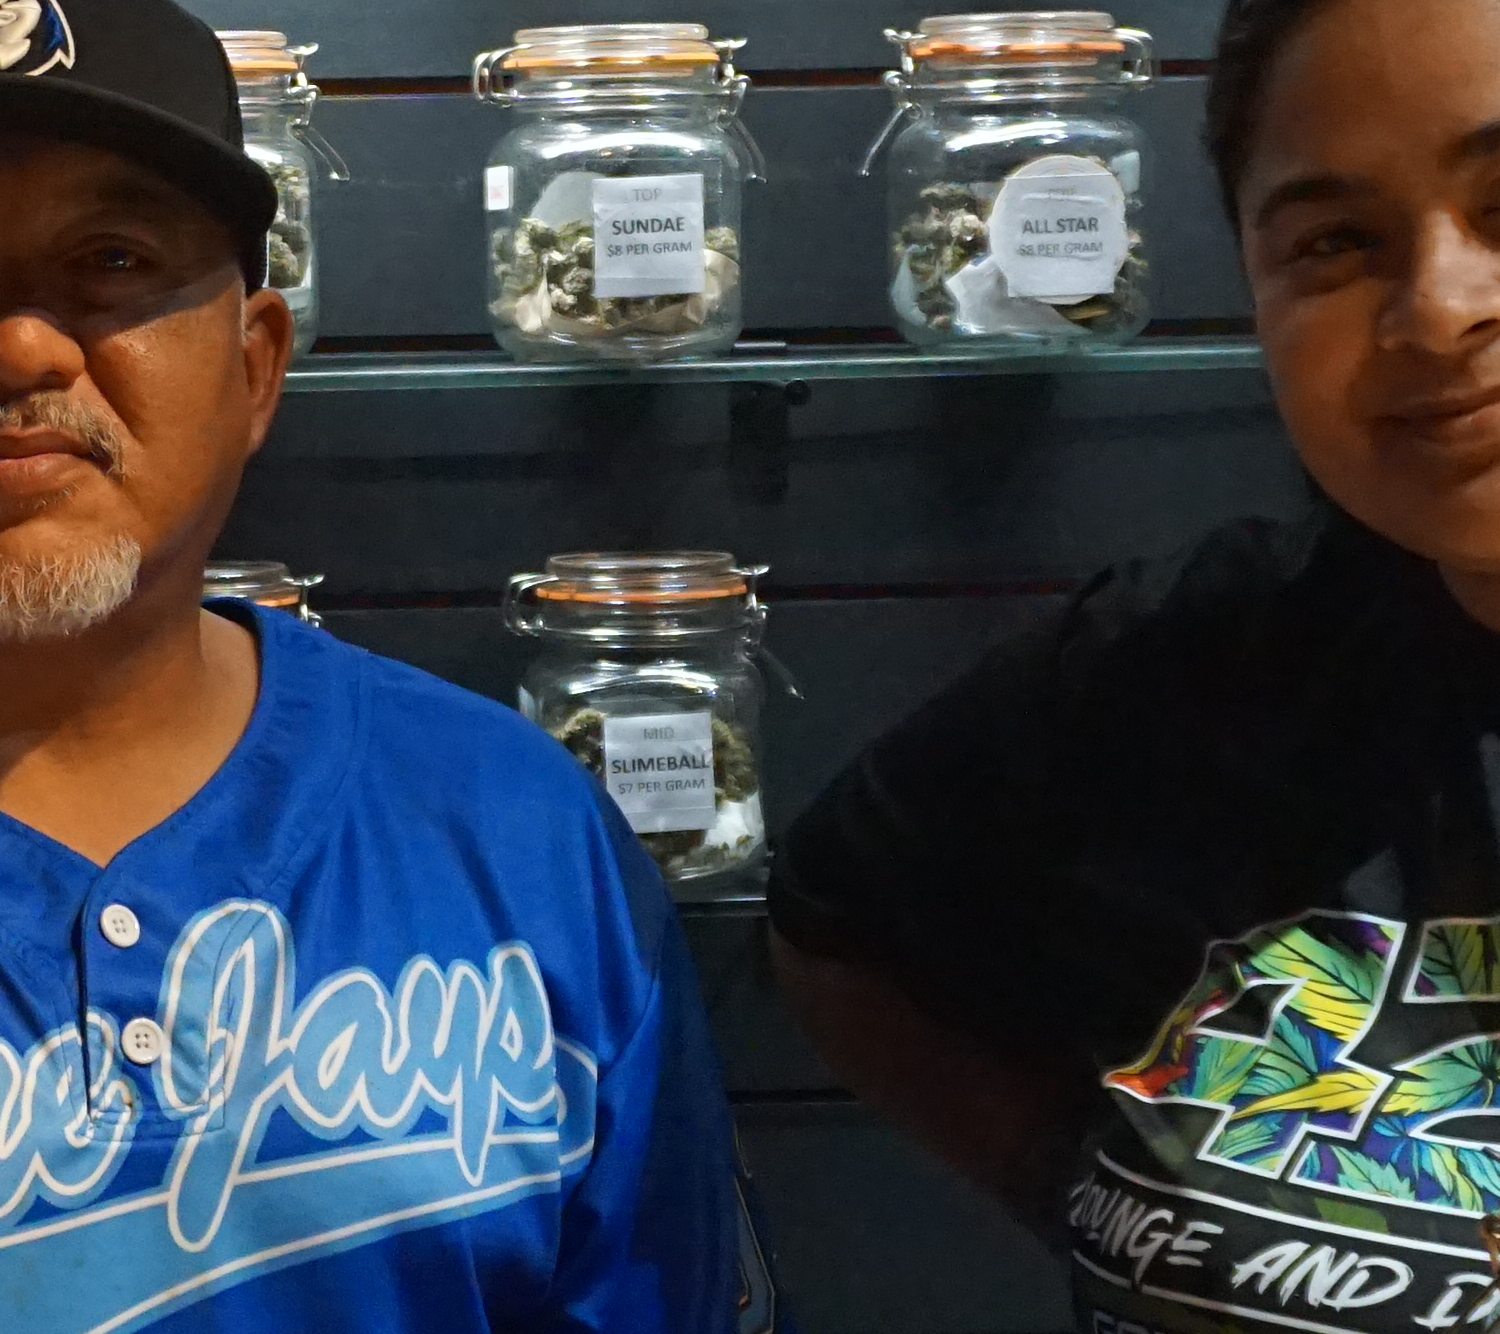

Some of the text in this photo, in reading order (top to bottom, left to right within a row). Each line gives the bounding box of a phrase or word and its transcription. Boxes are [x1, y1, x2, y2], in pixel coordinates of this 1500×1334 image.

[631, 188, 662, 202] TOP
[611, 216, 686, 235] SUNDAE
[1022, 217, 1100, 235] ALL STAR
[607, 241, 693, 258] $8 PER GRAM
[1037, 244, 1060, 255] PER
[1063, 241, 1103, 254] GRAM
[643, 726, 675, 740] MID
[611, 753, 711, 774] SLIMEBALL
[618, 778, 706, 795] $7 PER GRAM
[156, 896, 570, 1255] Jays
[1229, 1240, 1415, 1312] AND
